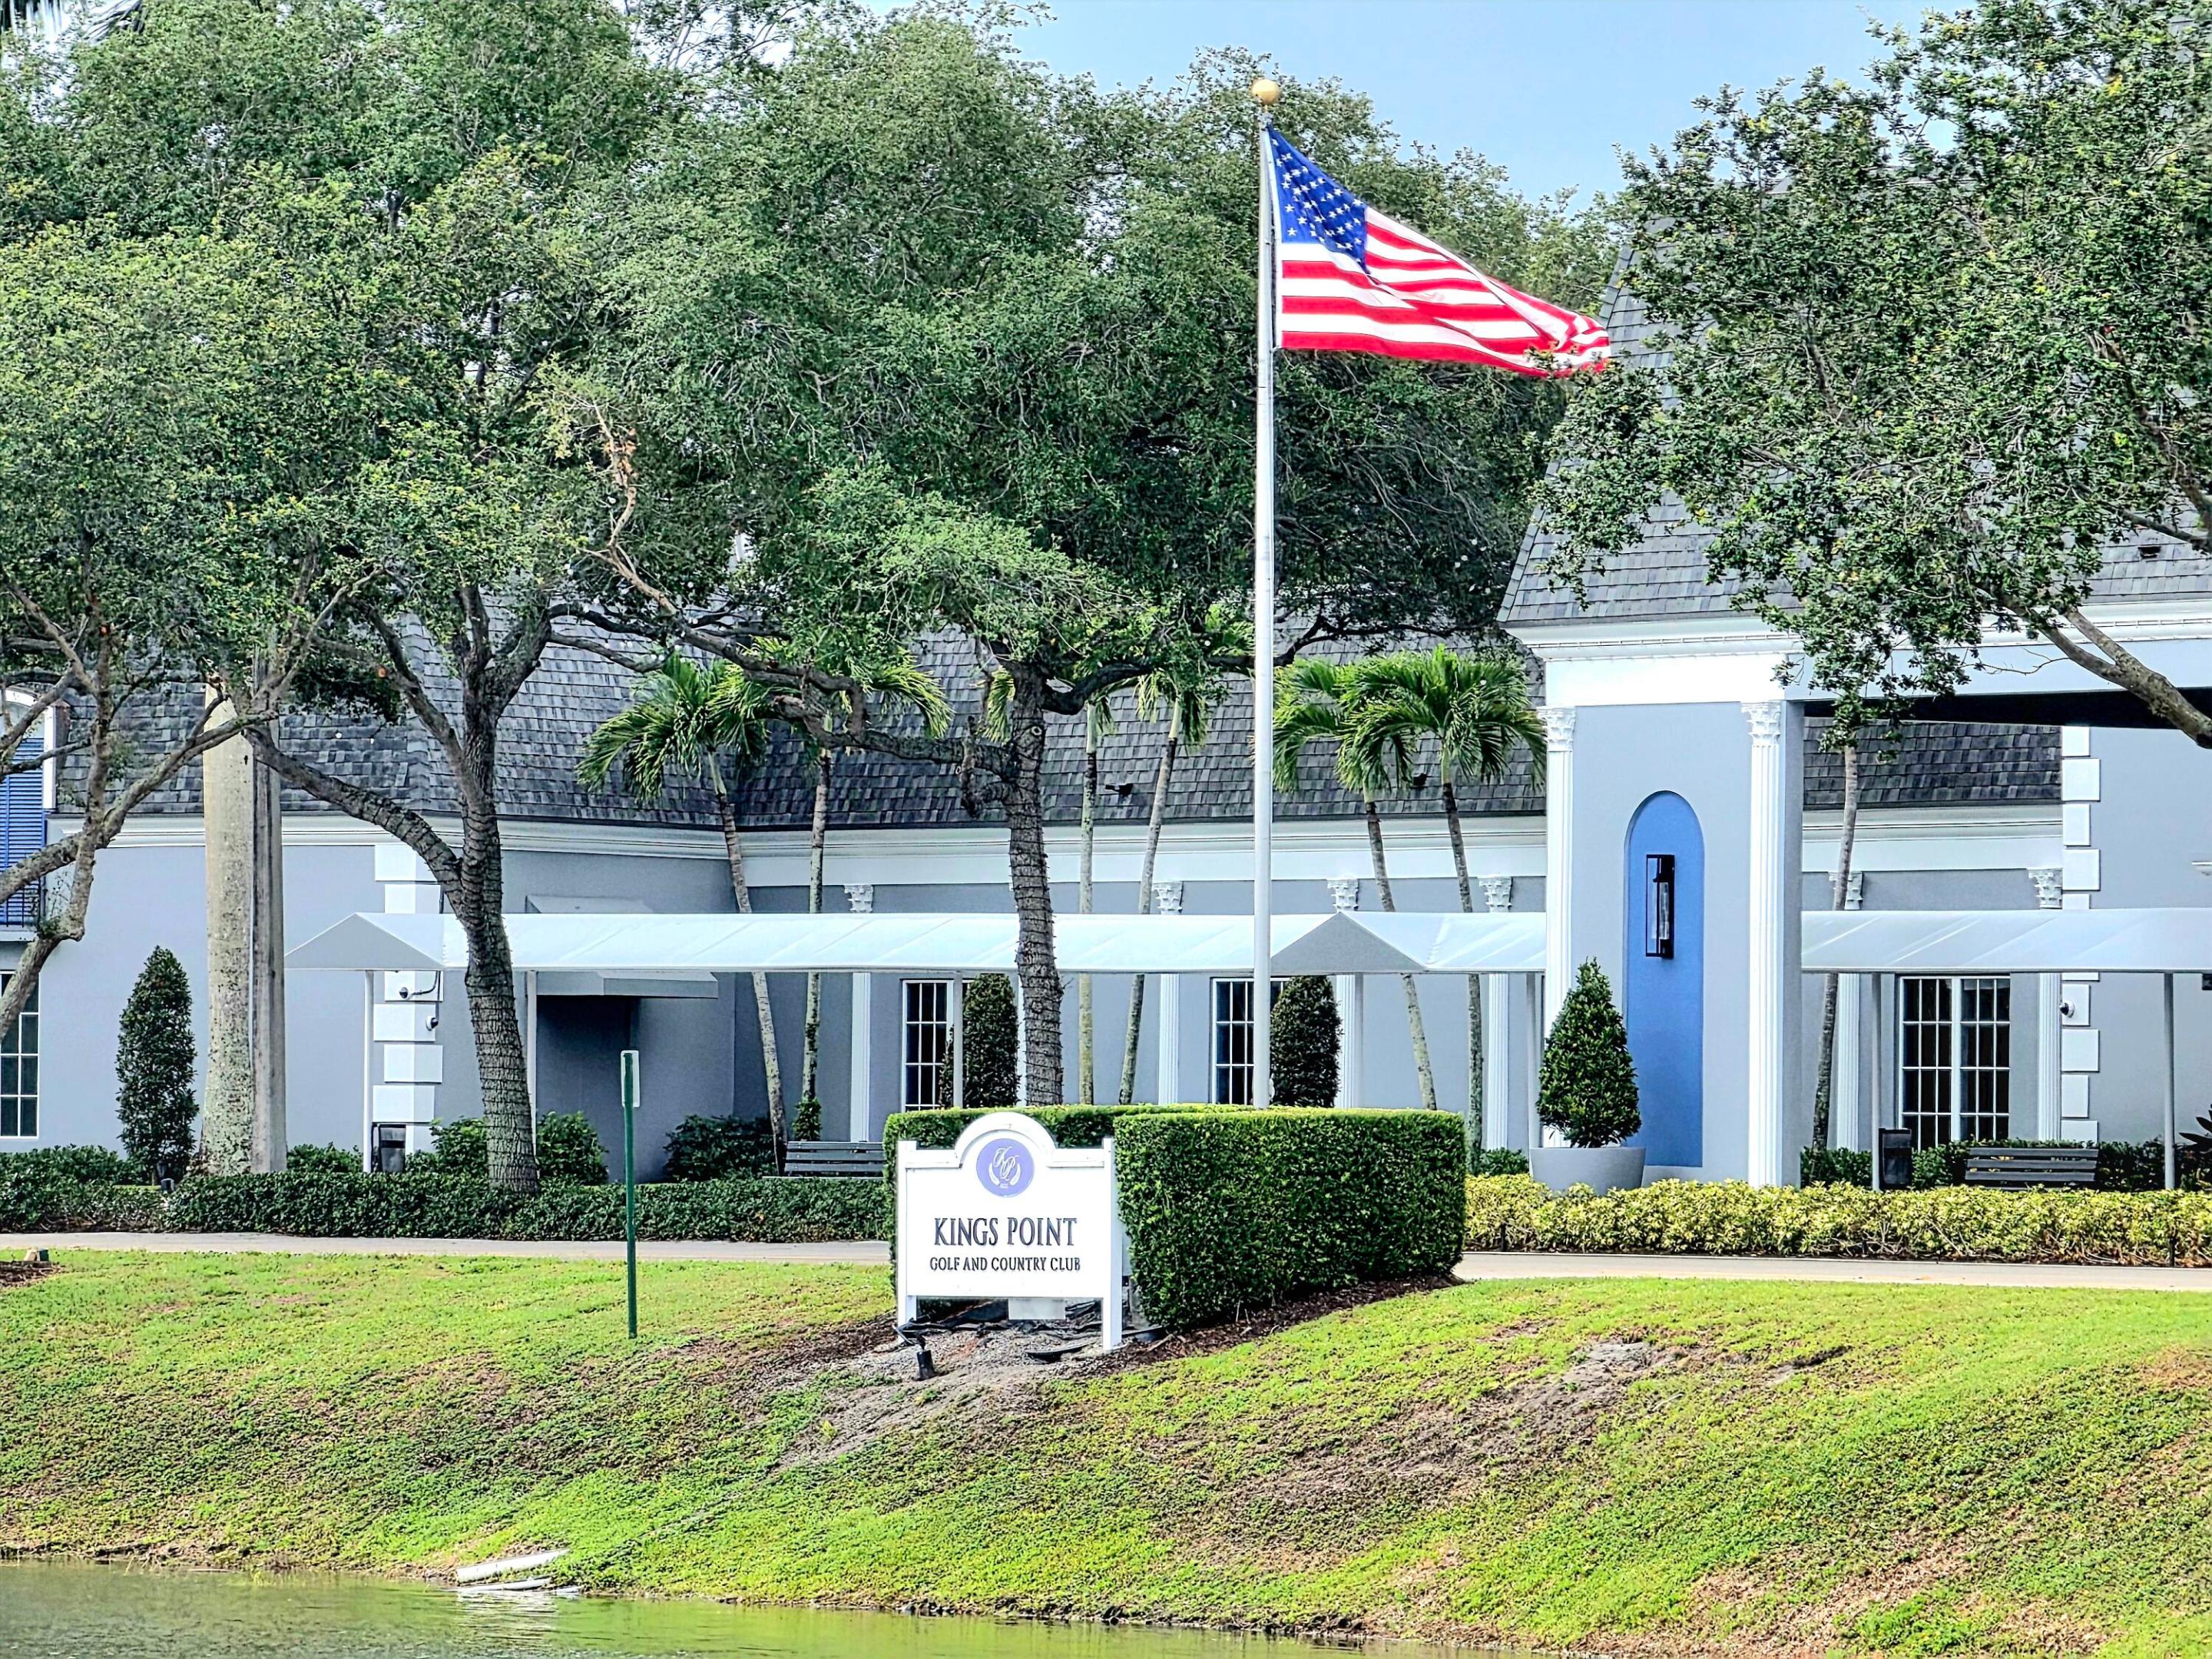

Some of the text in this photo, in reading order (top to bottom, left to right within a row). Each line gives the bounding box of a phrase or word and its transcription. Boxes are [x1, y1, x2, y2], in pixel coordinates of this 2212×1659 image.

[934, 1217, 1077, 1246] KINGS POINT
[929, 1257, 1081, 1271] GOLF AND COUNTRY CLUB
